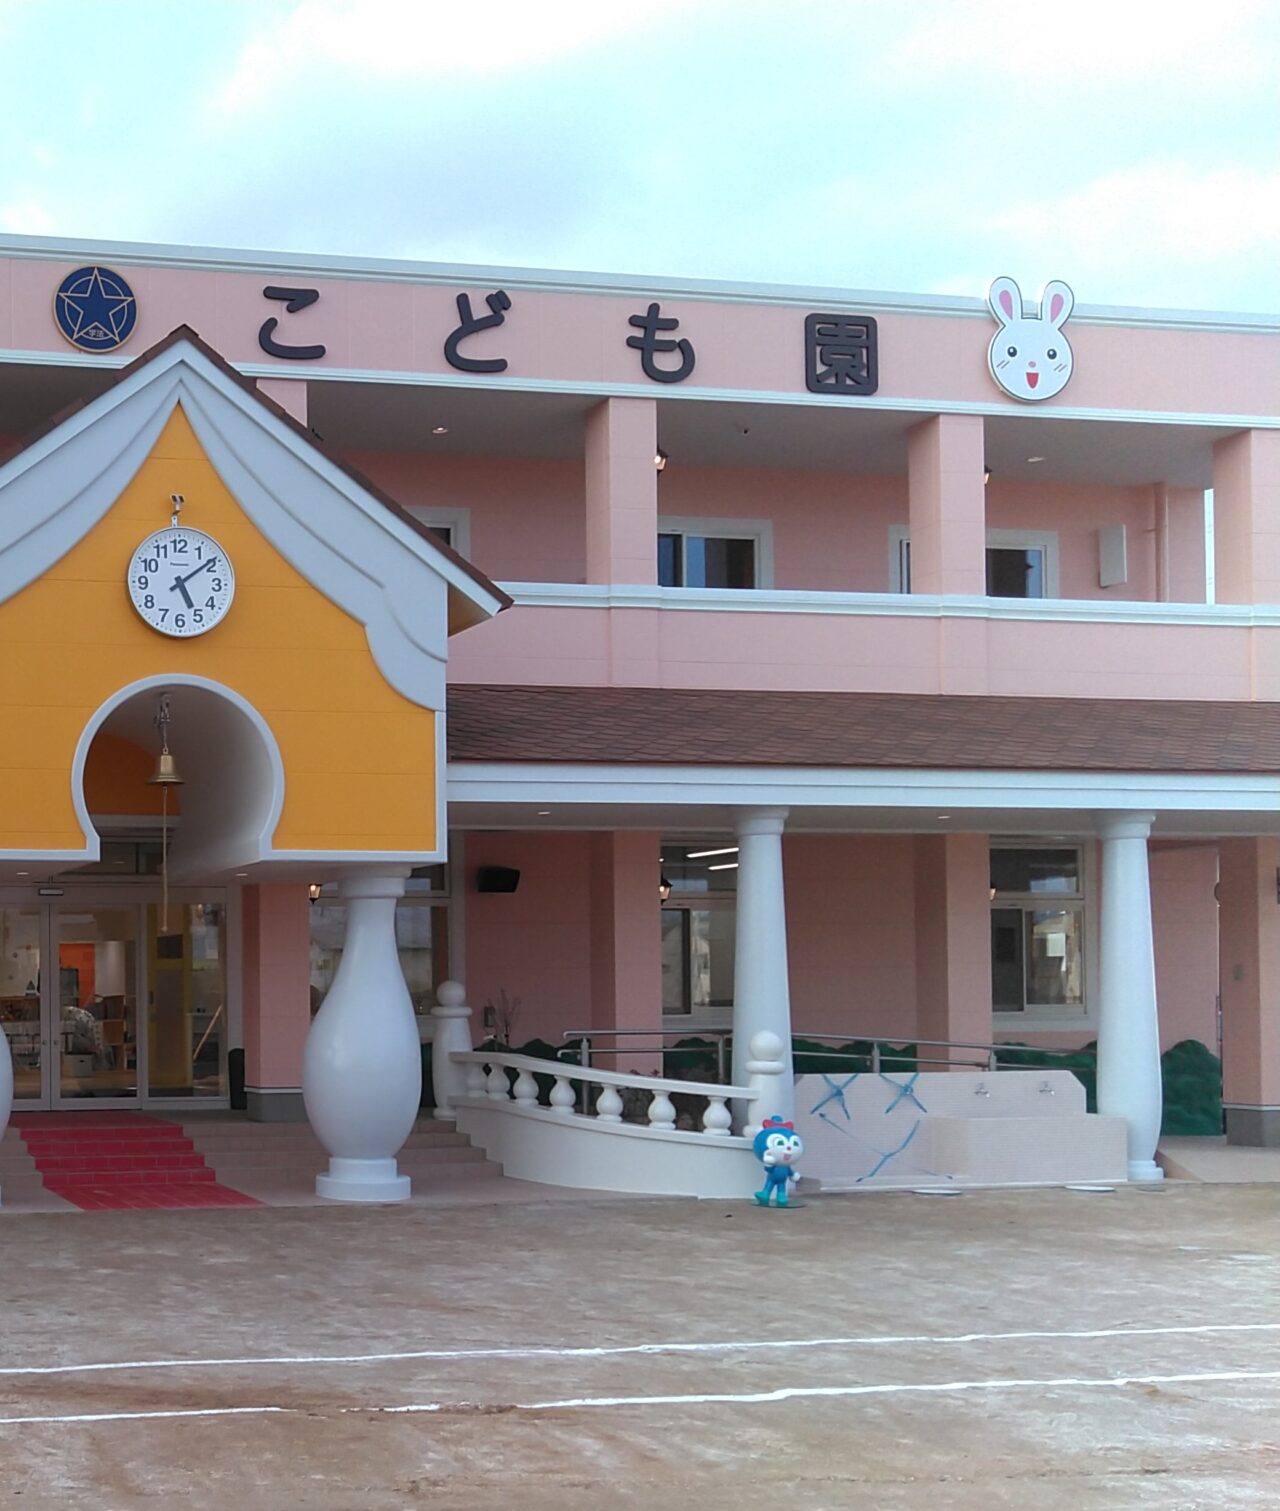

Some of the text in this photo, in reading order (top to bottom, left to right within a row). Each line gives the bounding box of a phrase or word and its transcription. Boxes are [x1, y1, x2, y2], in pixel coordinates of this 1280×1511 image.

[153, 544, 168, 558] 11
[170, 539, 188, 553] 12
[194, 546, 201, 560] 1
[141, 558, 158, 573] 10
[206, 558, 217, 573] 2
[138, 575, 149, 590] 9
[211, 578, 222, 592] 3
[144, 594, 155, 609] 8
[205, 596, 216, 610] 4
[158, 608, 169, 623] 7
[175, 613, 186, 628] 6
[193, 609, 203, 623] 5
